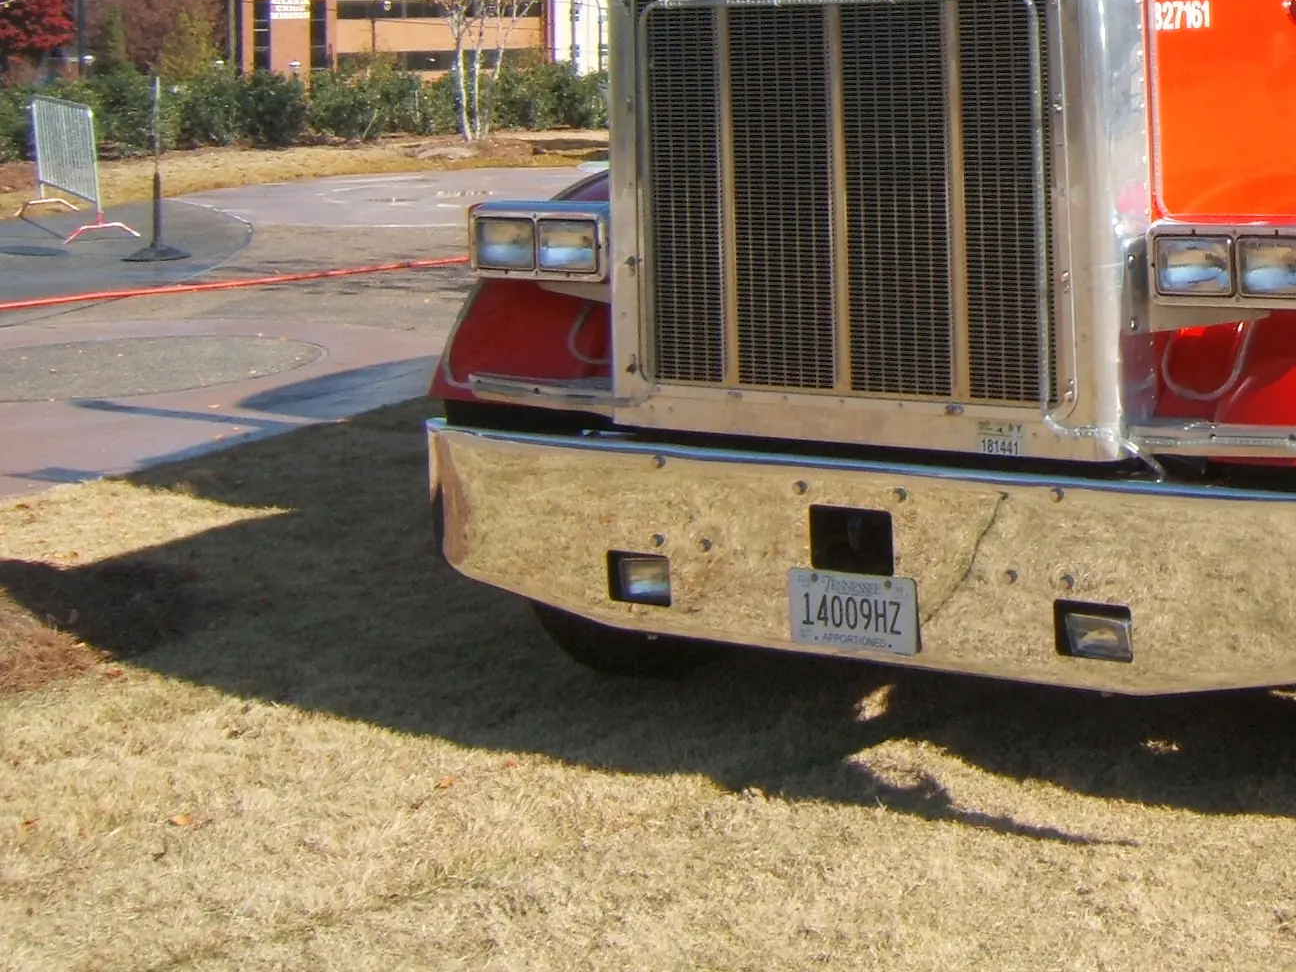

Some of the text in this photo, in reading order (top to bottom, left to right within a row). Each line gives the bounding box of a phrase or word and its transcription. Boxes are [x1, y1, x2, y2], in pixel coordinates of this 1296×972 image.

[981, 438, 1020, 456] 181441
[801, 591, 902, 635] 14009HZ
[822, 632, 888, 648] APPORTIONED
